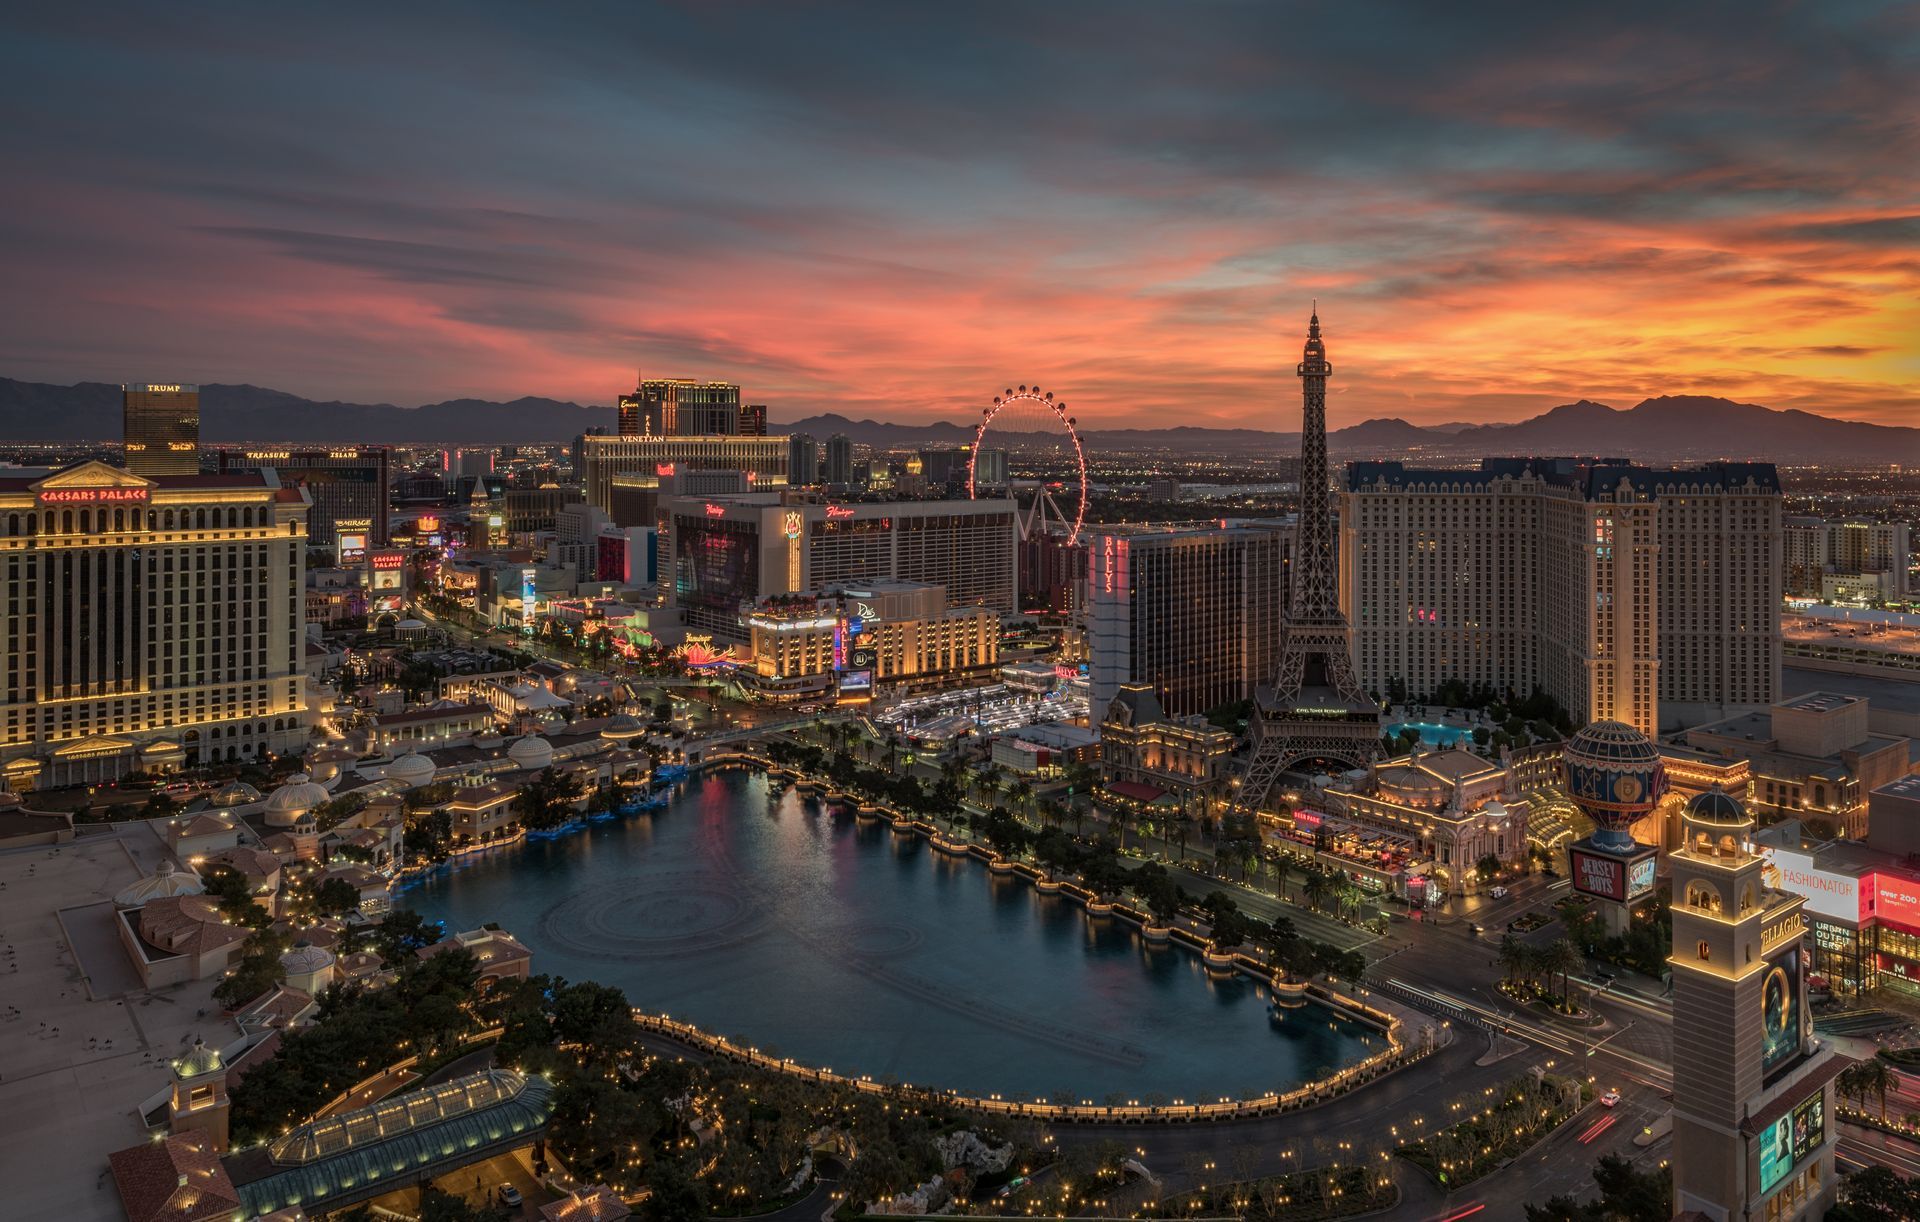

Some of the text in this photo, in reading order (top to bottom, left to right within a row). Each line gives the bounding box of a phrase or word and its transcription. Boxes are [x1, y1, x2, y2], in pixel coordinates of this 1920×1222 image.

[147, 384, 180, 392] TRUMP
[40, 490, 147, 501] CAESARS PALACE
[826, 506, 855, 518] Flamingo
[341, 519, 371, 527] MIRAGE
[373, 555, 403, 563] CAESARS
[1104, 536, 1114, 593] BALLYS
[1581, 857, 1616, 879] JERSEY
[1588, 874, 1613, 894] BOYS
[1783, 868, 1853, 896] FASHIONATOR
[1880, 889, 1917, 904] over 200
[1761, 913, 1800, 946] ELLAGIO
[1816, 921, 1850, 937] URBAN
[1816, 930, 1850, 945] OUTFIT
[1816, 938, 1840, 951] TERS
[1894, 963, 1905, 975] M
